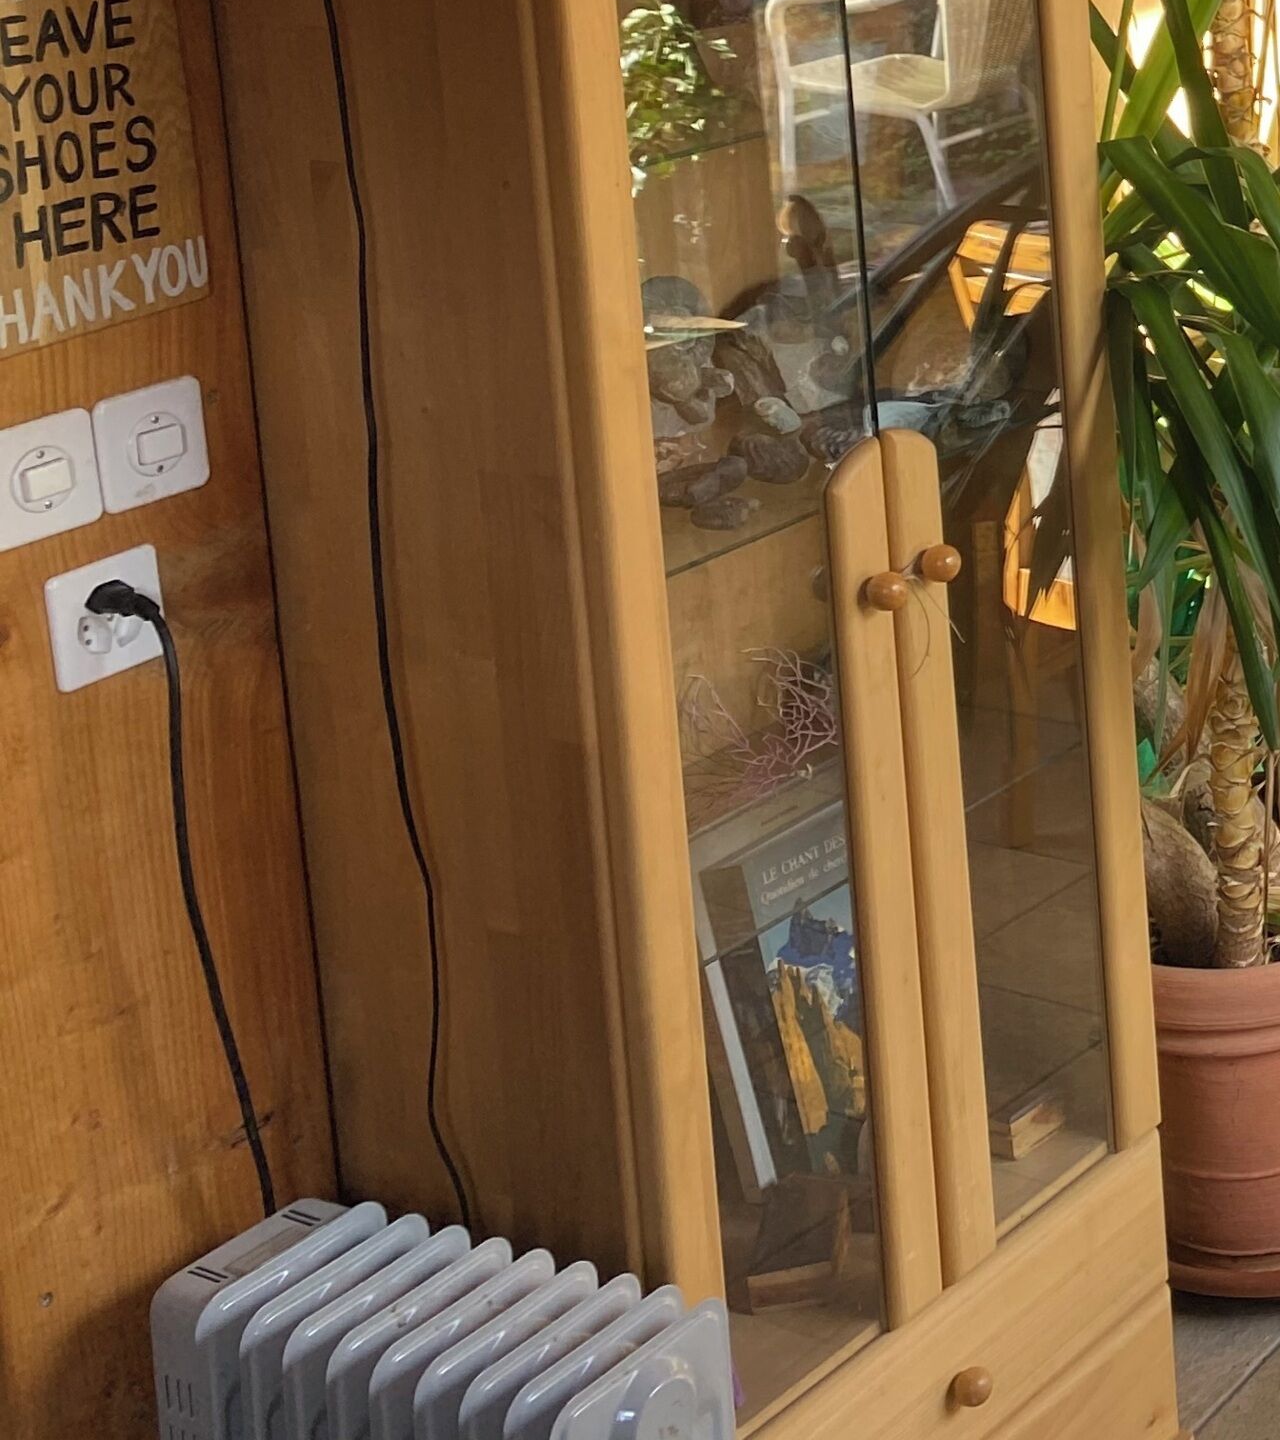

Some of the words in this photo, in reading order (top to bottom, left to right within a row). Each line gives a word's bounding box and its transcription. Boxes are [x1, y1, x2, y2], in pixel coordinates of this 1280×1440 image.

[0, 63, 136, 132] YOUR
[13, 184, 161, 269] HERE
[131, 235, 208, 304] YOU
[762, 865, 778, 885] LE
[781, 845, 820, 875] CHANT
[823, 834, 846, 854] DES
